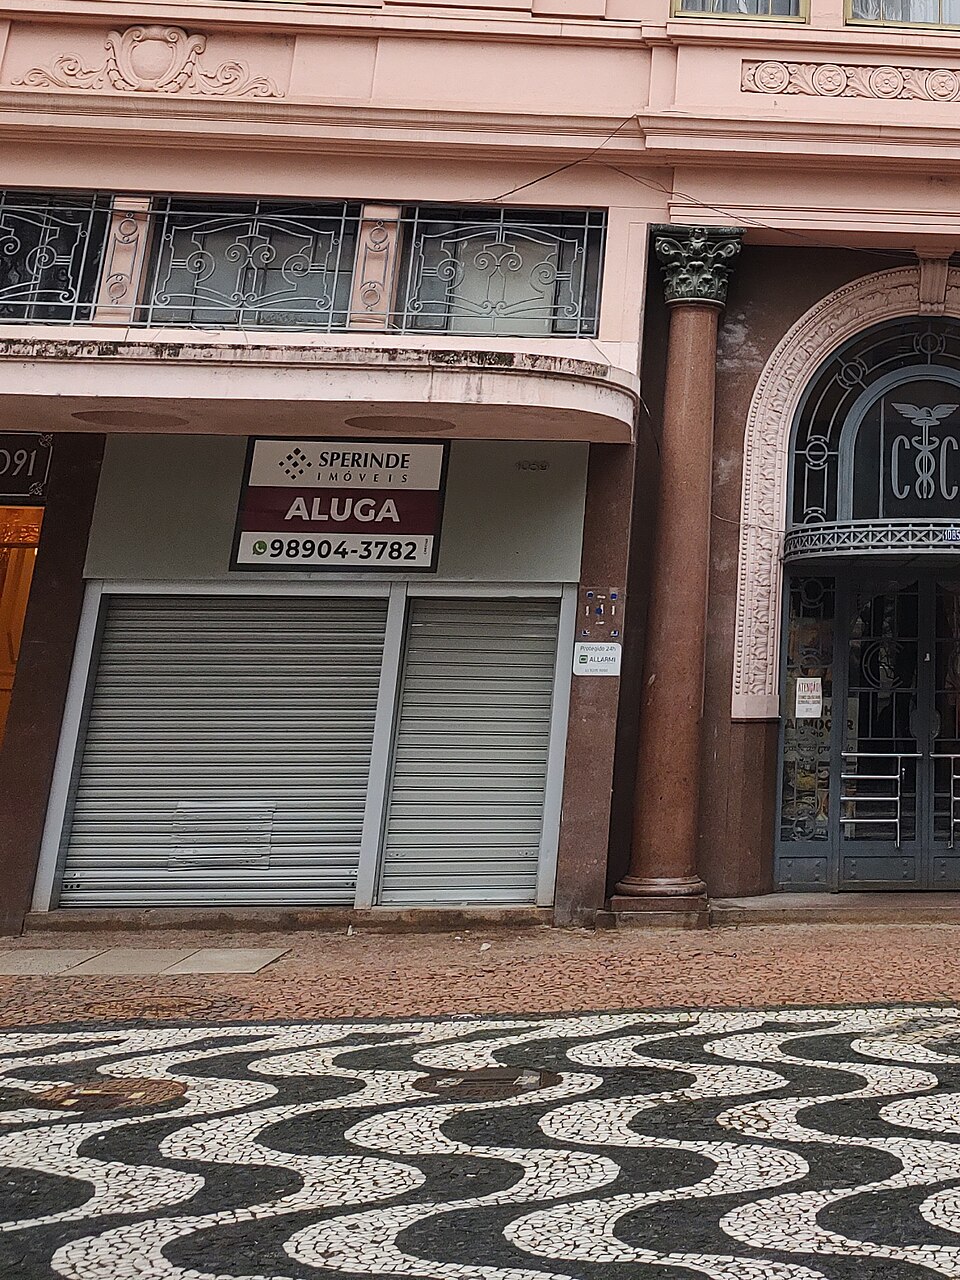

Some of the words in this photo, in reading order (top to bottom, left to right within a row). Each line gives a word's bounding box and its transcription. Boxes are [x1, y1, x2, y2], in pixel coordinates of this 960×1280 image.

[318, 451, 411, 469] SPERINDE
[317, 471, 408, 483] IMÓVEIS
[284, 496, 400, 522] ALUGA
[269, 538, 417, 560] 98904-3782
